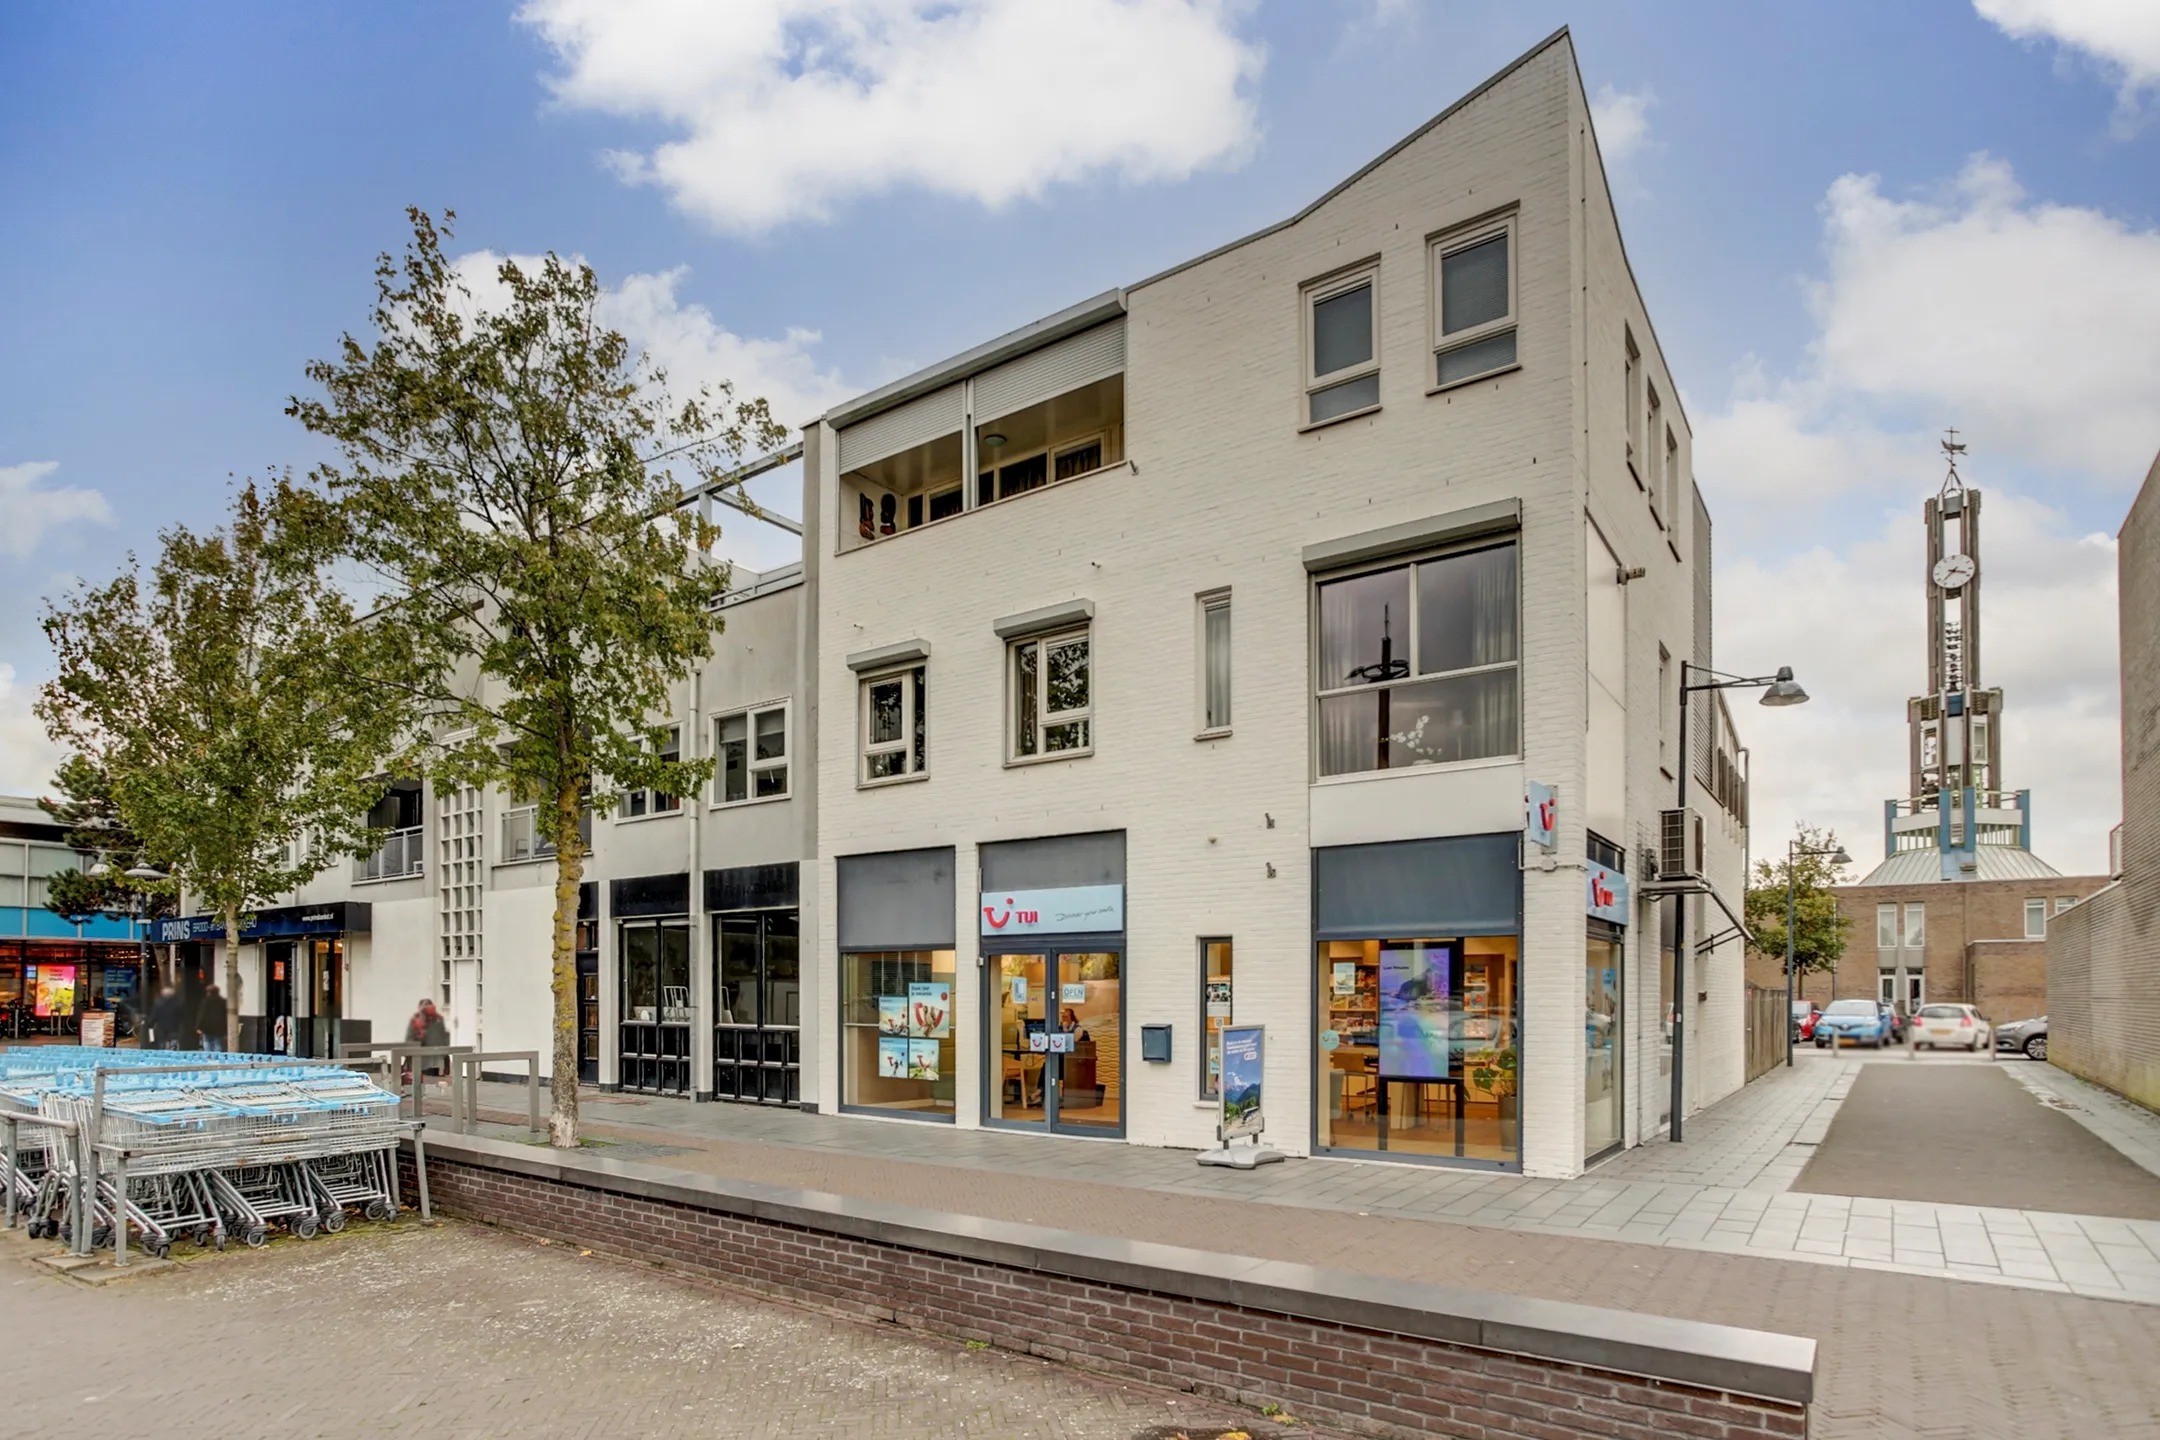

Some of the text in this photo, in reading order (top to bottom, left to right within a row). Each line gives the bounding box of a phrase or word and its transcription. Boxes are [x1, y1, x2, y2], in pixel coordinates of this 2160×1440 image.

[1015, 910, 1038, 924] TUI
[161, 920, 191, 941] PRINS
[1063, 988, 1084, 998] OPEN
